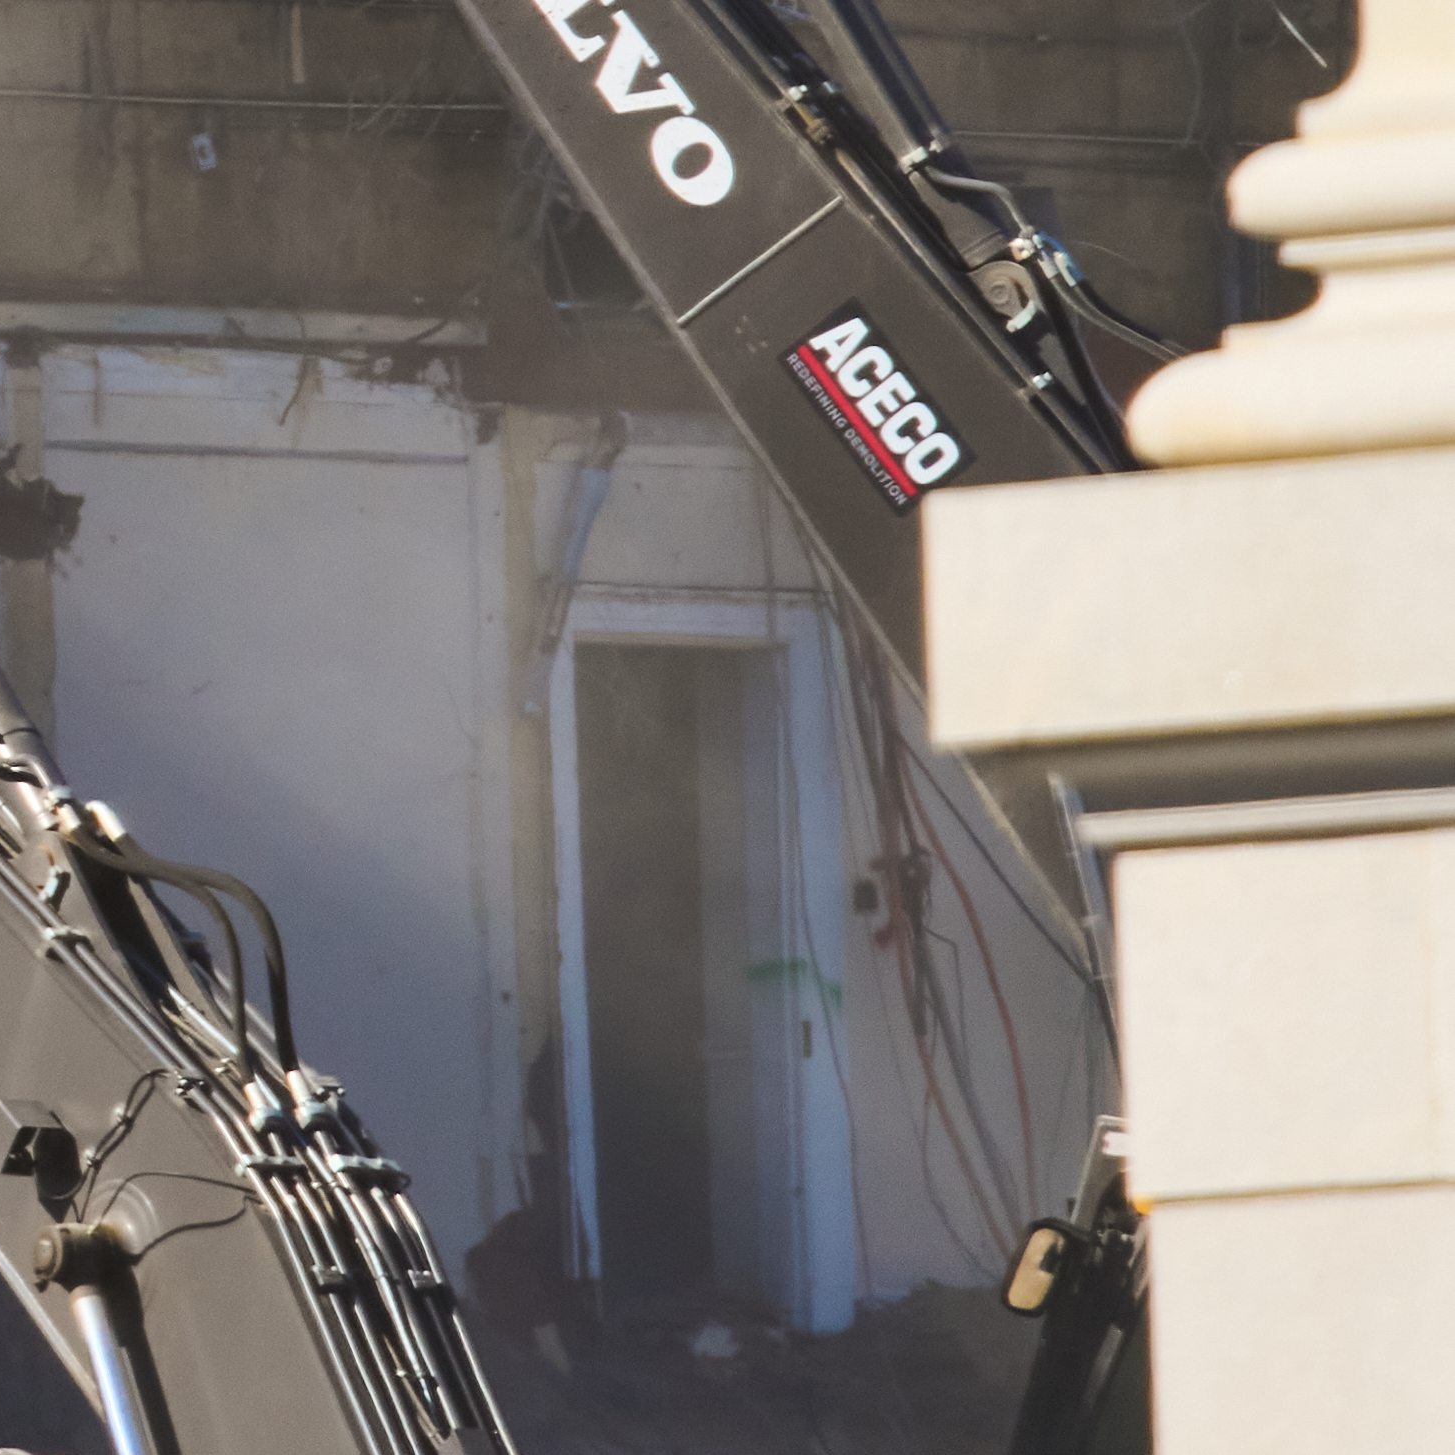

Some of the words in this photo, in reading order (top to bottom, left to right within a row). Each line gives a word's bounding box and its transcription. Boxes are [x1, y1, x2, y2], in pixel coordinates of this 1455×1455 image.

[787, 352, 847, 429] REDEFINING
[844, 429, 908, 506] DEMOLITION
[808, 317, 960, 484] ACECO
